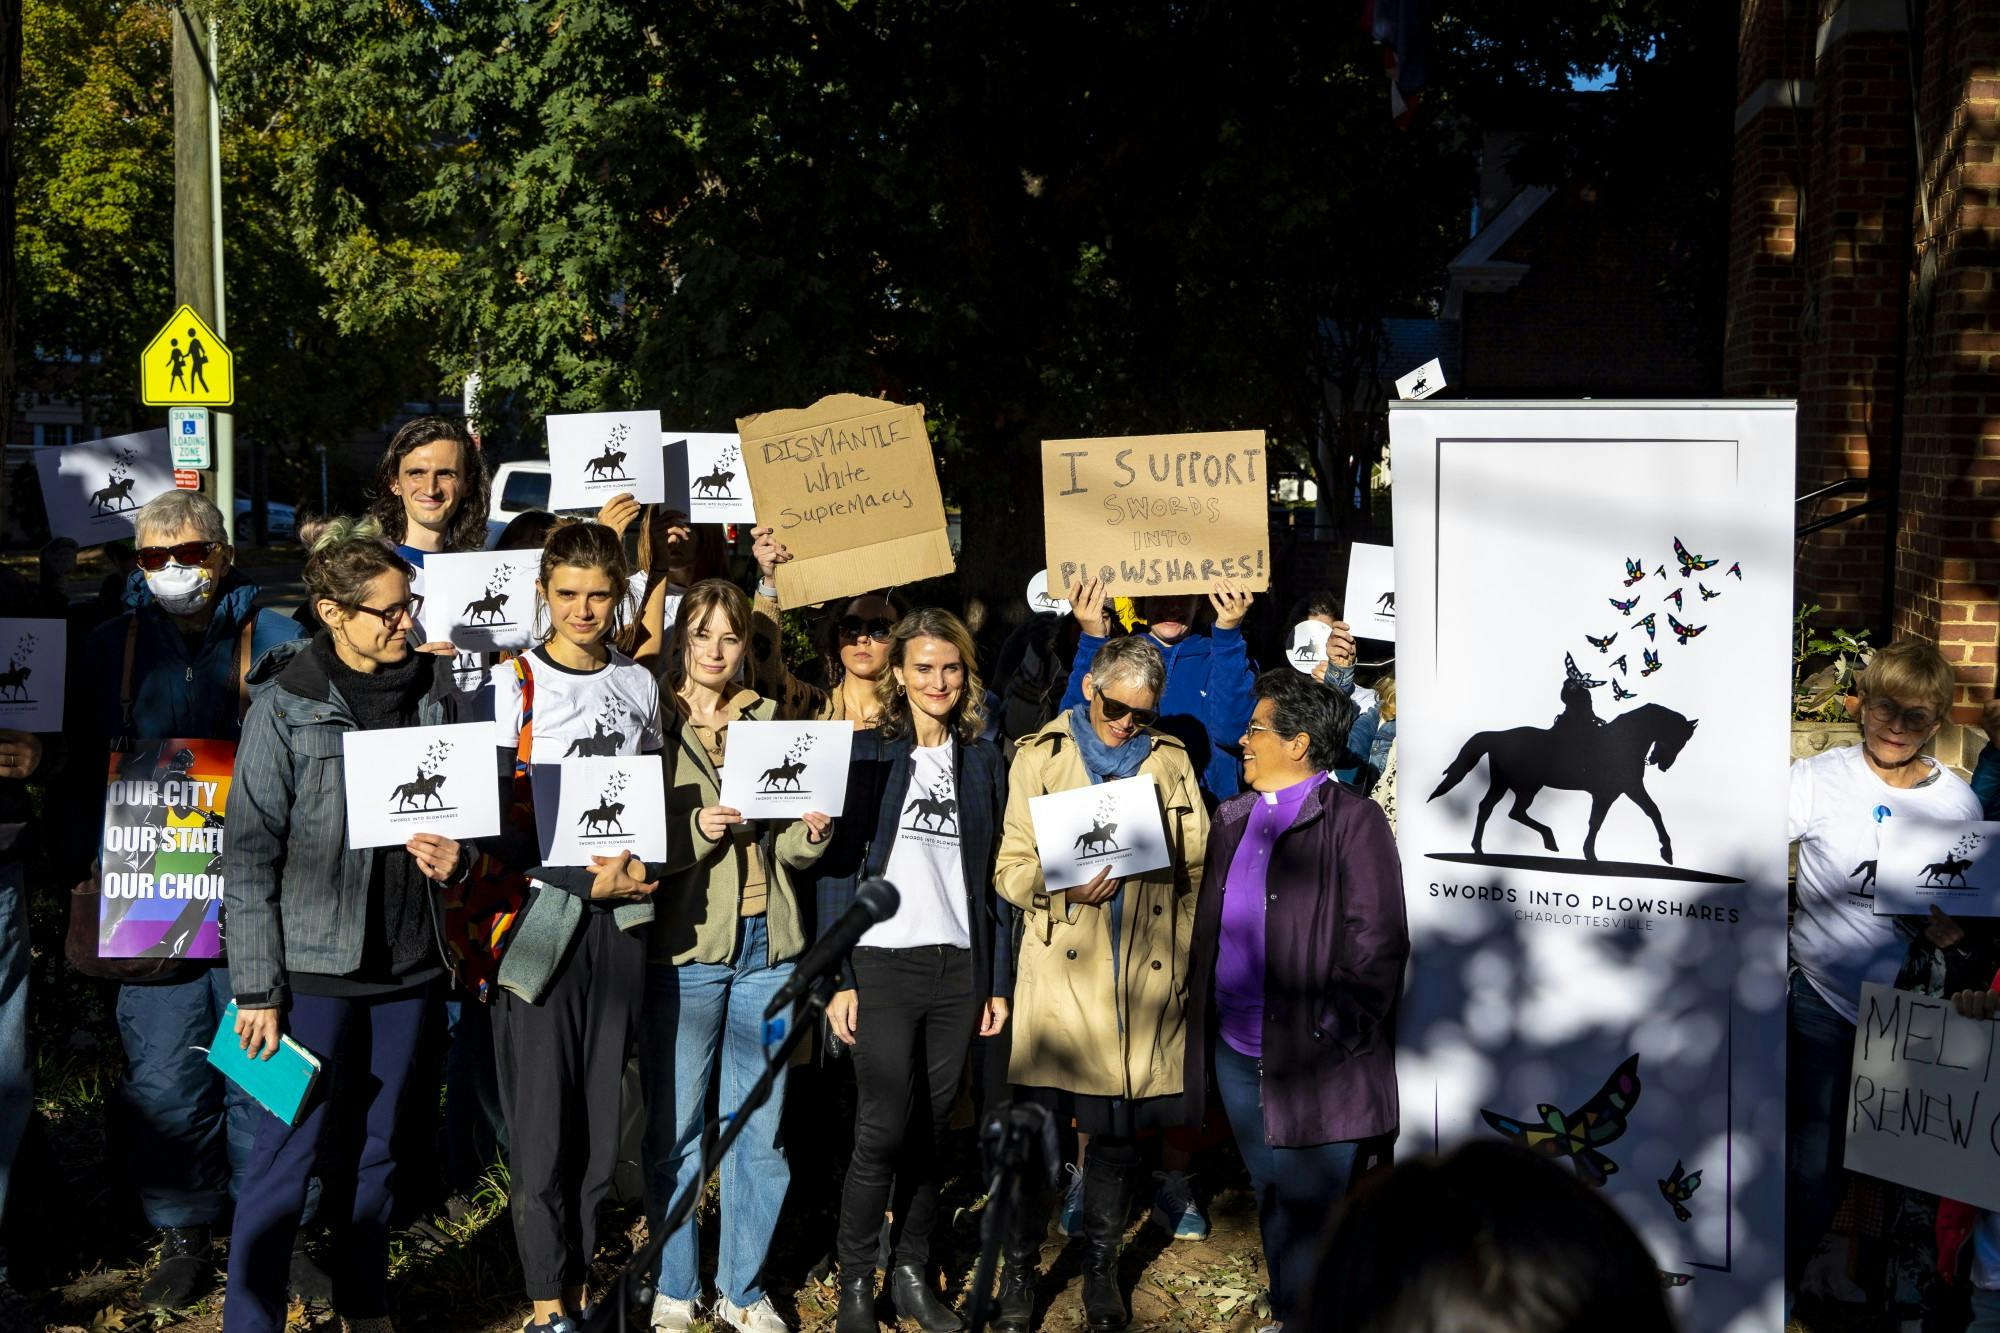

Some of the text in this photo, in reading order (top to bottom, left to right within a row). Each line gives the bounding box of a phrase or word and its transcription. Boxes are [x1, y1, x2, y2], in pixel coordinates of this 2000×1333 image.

[188, 412, 204, 420] MIN
[173, 436, 205, 446] LOADING
[180, 447, 200, 457] ZONE
[761, 419, 911, 464] DISMANTLE
[804, 461, 871, 494] White
[1059, 448, 1262, 496] I SUPPORT
[1103, 493, 1221, 526] SWORDS
[1131, 529, 1192, 551] INTO
[1060, 549, 1265, 589] PLOWSHARES!
[109, 780, 218, 807] OUR CITY
[105, 825, 157, 852] OUR
[104, 872, 155, 899] OUR
[1429, 882, 1740, 924] SWORDS INTO PLOWSHARES
[1514, 909, 1655, 931] CHARLOTTESVILLE
[1852, 1075, 1980, 1149] RENEW
